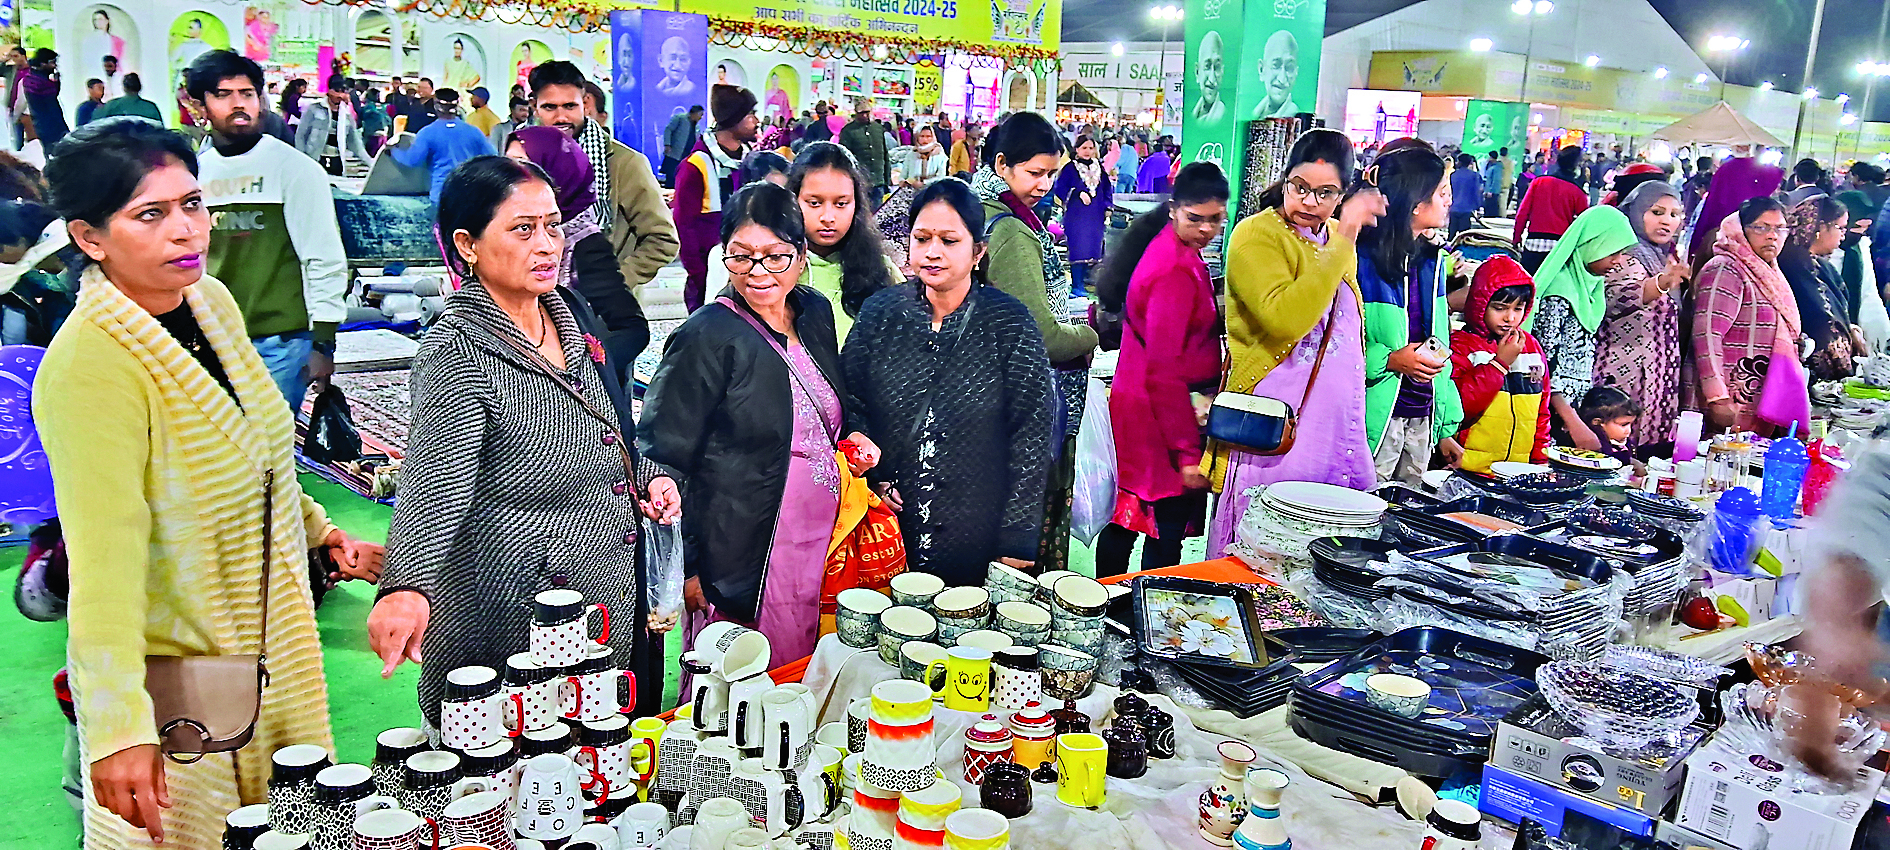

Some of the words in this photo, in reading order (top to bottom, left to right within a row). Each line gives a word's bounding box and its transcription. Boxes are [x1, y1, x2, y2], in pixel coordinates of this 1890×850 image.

[754, 7, 776, 18] आप
[781, 8, 804, 22] सभी
[903, 0, 957, 18] 2024-25
[1079, 63, 1108, 78] साल
[873, 564, 905, 582] STORE
